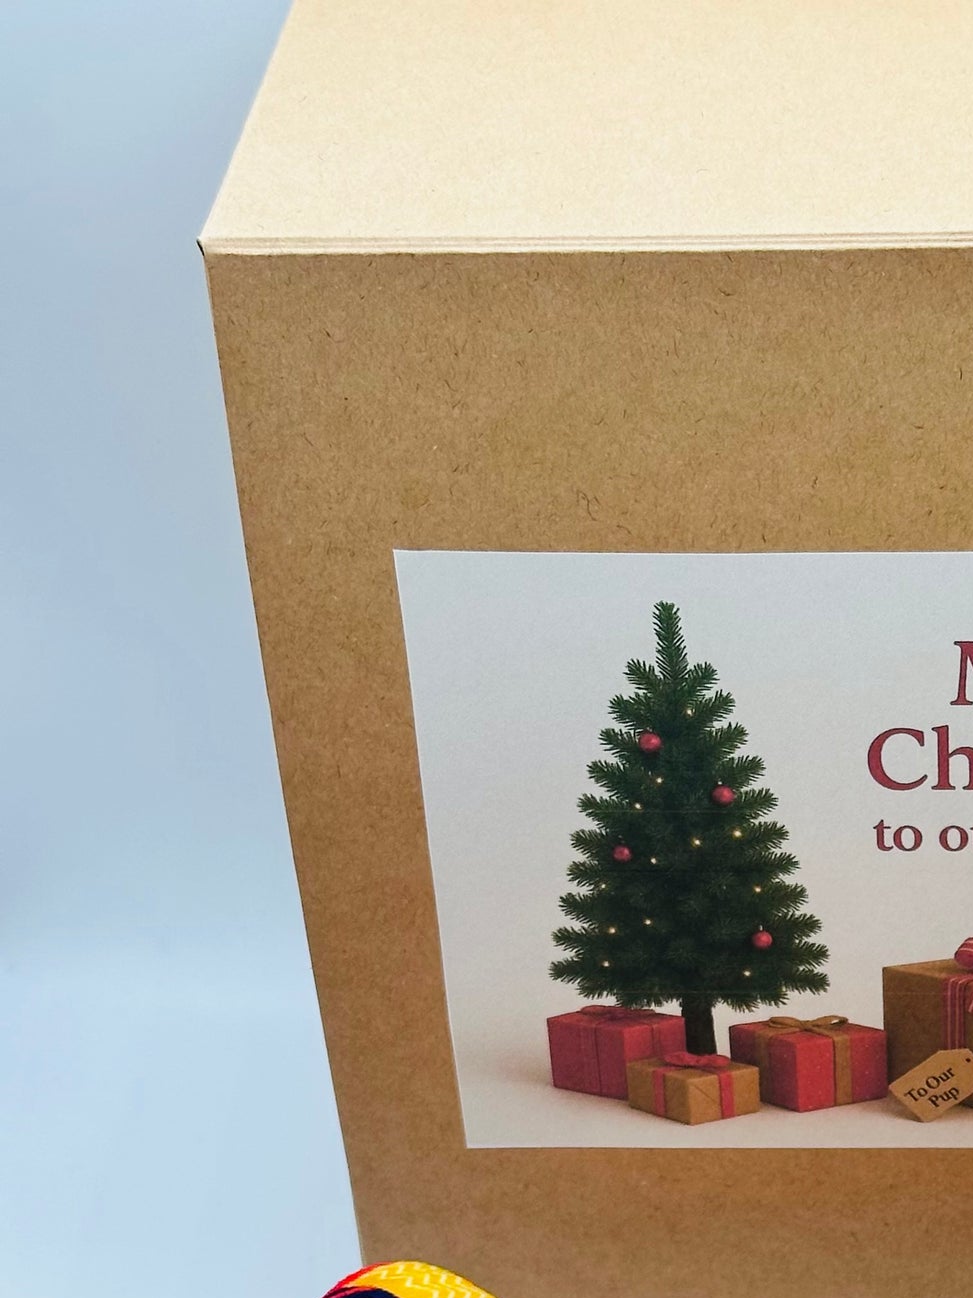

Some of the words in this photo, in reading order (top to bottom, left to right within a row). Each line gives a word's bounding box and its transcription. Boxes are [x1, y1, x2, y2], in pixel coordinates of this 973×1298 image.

[874, 819, 923, 852] to
[903, 1087, 928, 1102] To
[925, 1067, 956, 1089] Our
[927, 1087, 960, 1108] Pup
